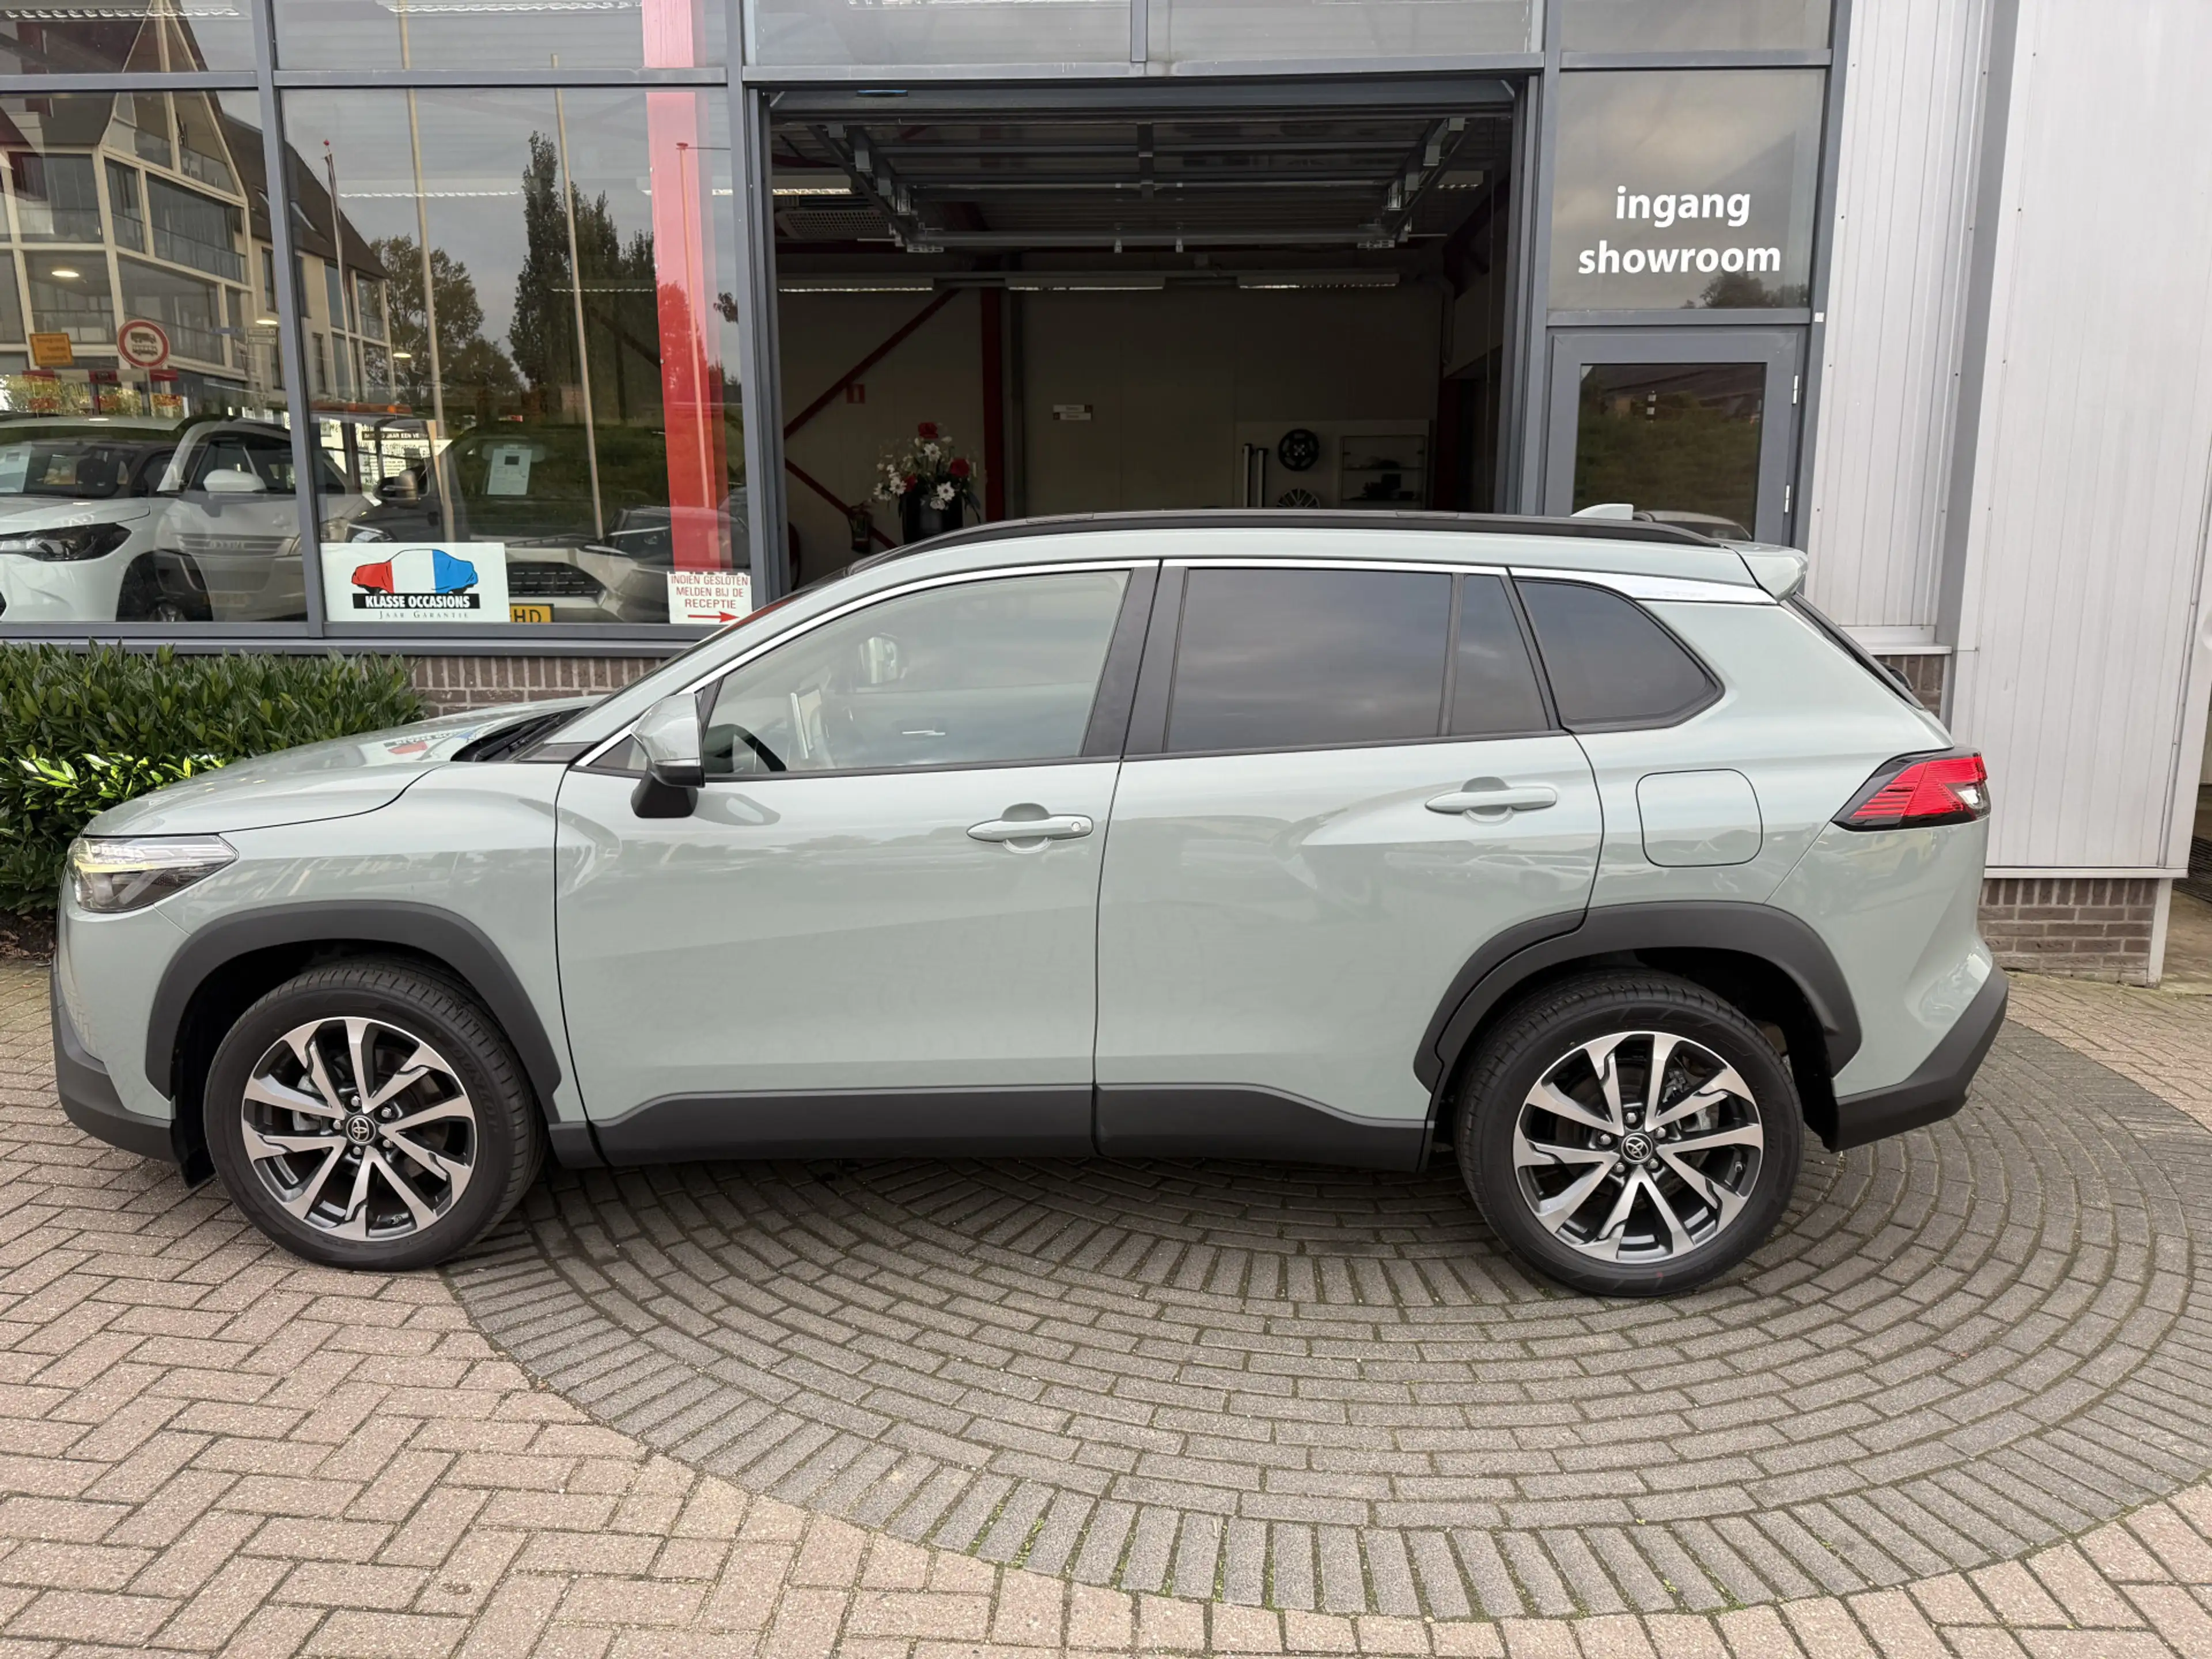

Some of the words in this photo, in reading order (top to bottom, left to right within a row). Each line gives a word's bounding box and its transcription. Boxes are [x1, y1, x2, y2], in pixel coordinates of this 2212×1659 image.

[1615, 185, 1751, 227] ingang
[1578, 240, 1781, 274] showroom
[671, 575, 700, 584] INDIEN
[704, 575, 748, 586] GESLOTEN
[676, 586, 711, 596] MELDEN
[715, 588, 729, 597] BIJ
[733, 588, 744, 597] DE
[365, 595, 406, 608] KLASSE
[408, 595, 470, 608] OCCASIONS
[685, 599, 736, 609] RECEPTIE
[379, 611, 405, 619] JAAR
[413, 611, 469, 619] GARANTIE
